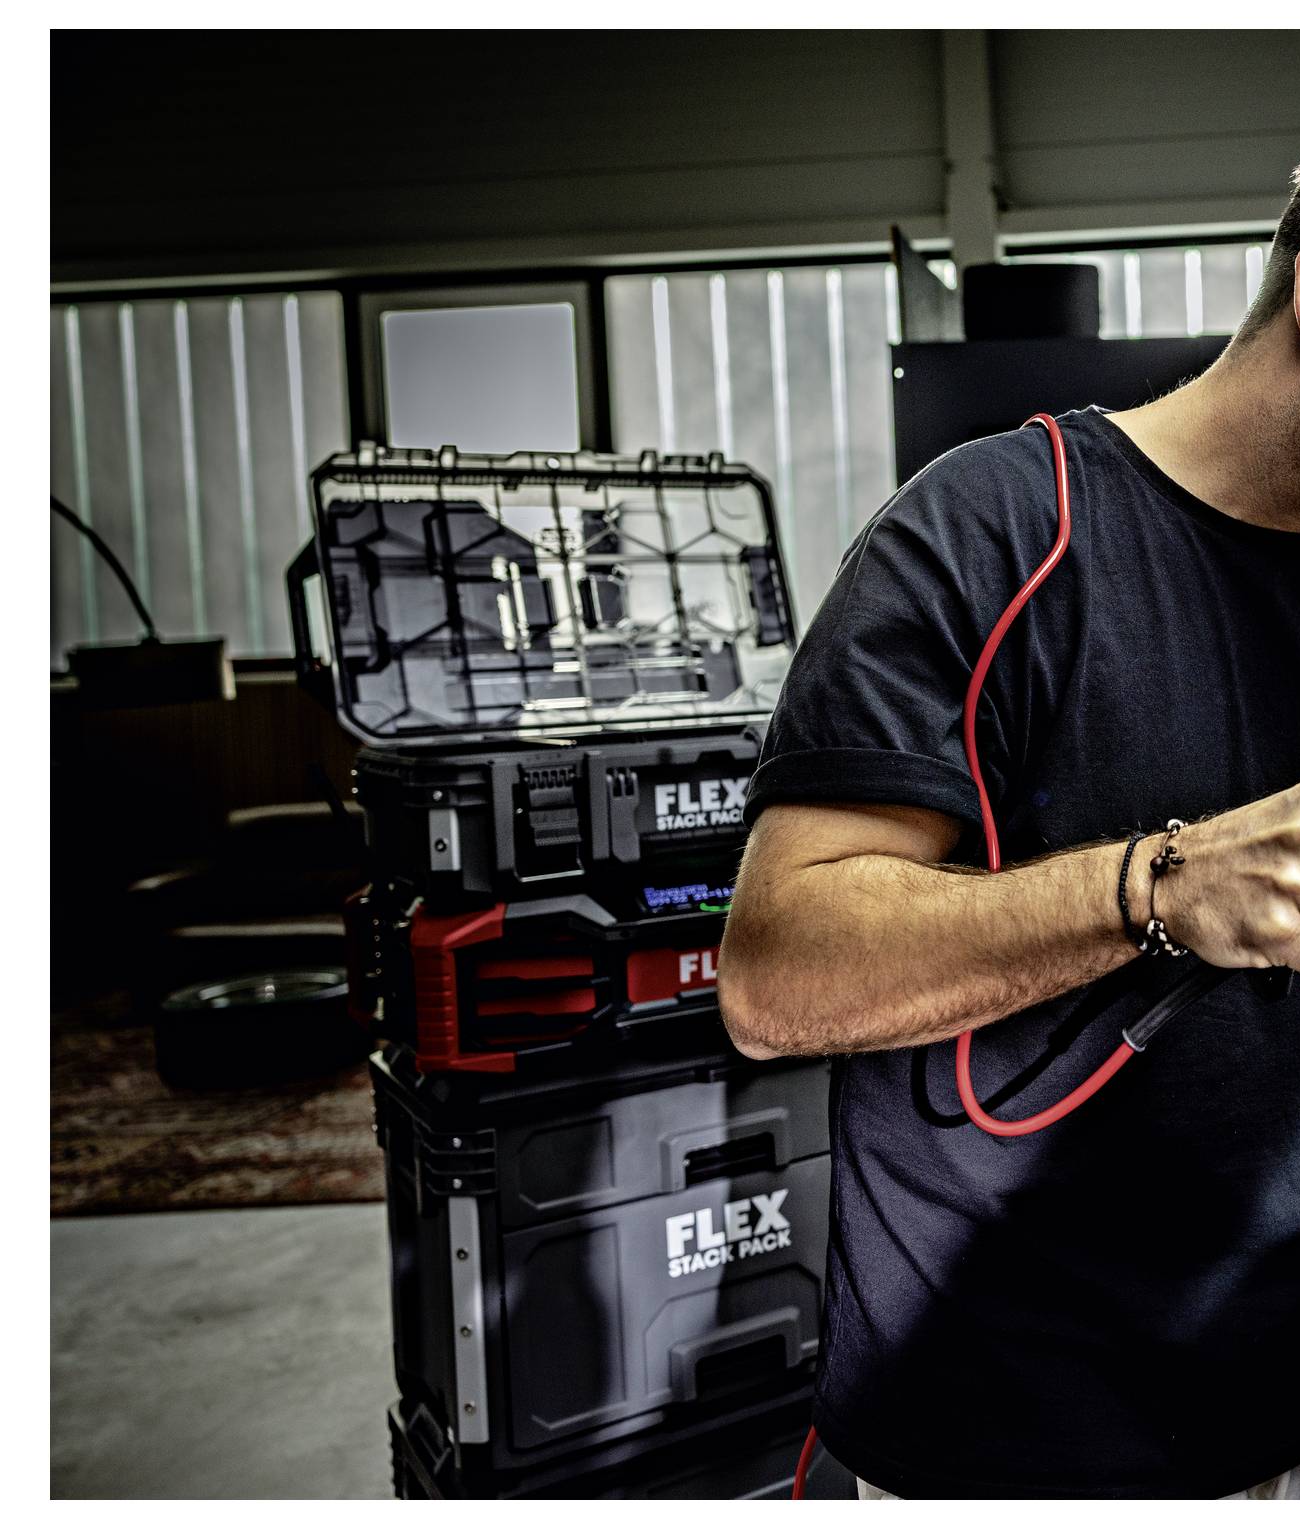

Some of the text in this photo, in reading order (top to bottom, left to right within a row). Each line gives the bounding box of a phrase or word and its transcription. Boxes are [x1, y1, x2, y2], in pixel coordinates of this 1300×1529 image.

[655, 777, 750, 817] FLEX
[656, 808, 743, 832] STACK PAC
[679, 951, 719, 984] FL
[665, 1188, 791, 1260] FLEX
[668, 1228, 792, 1278] STACK PACK
